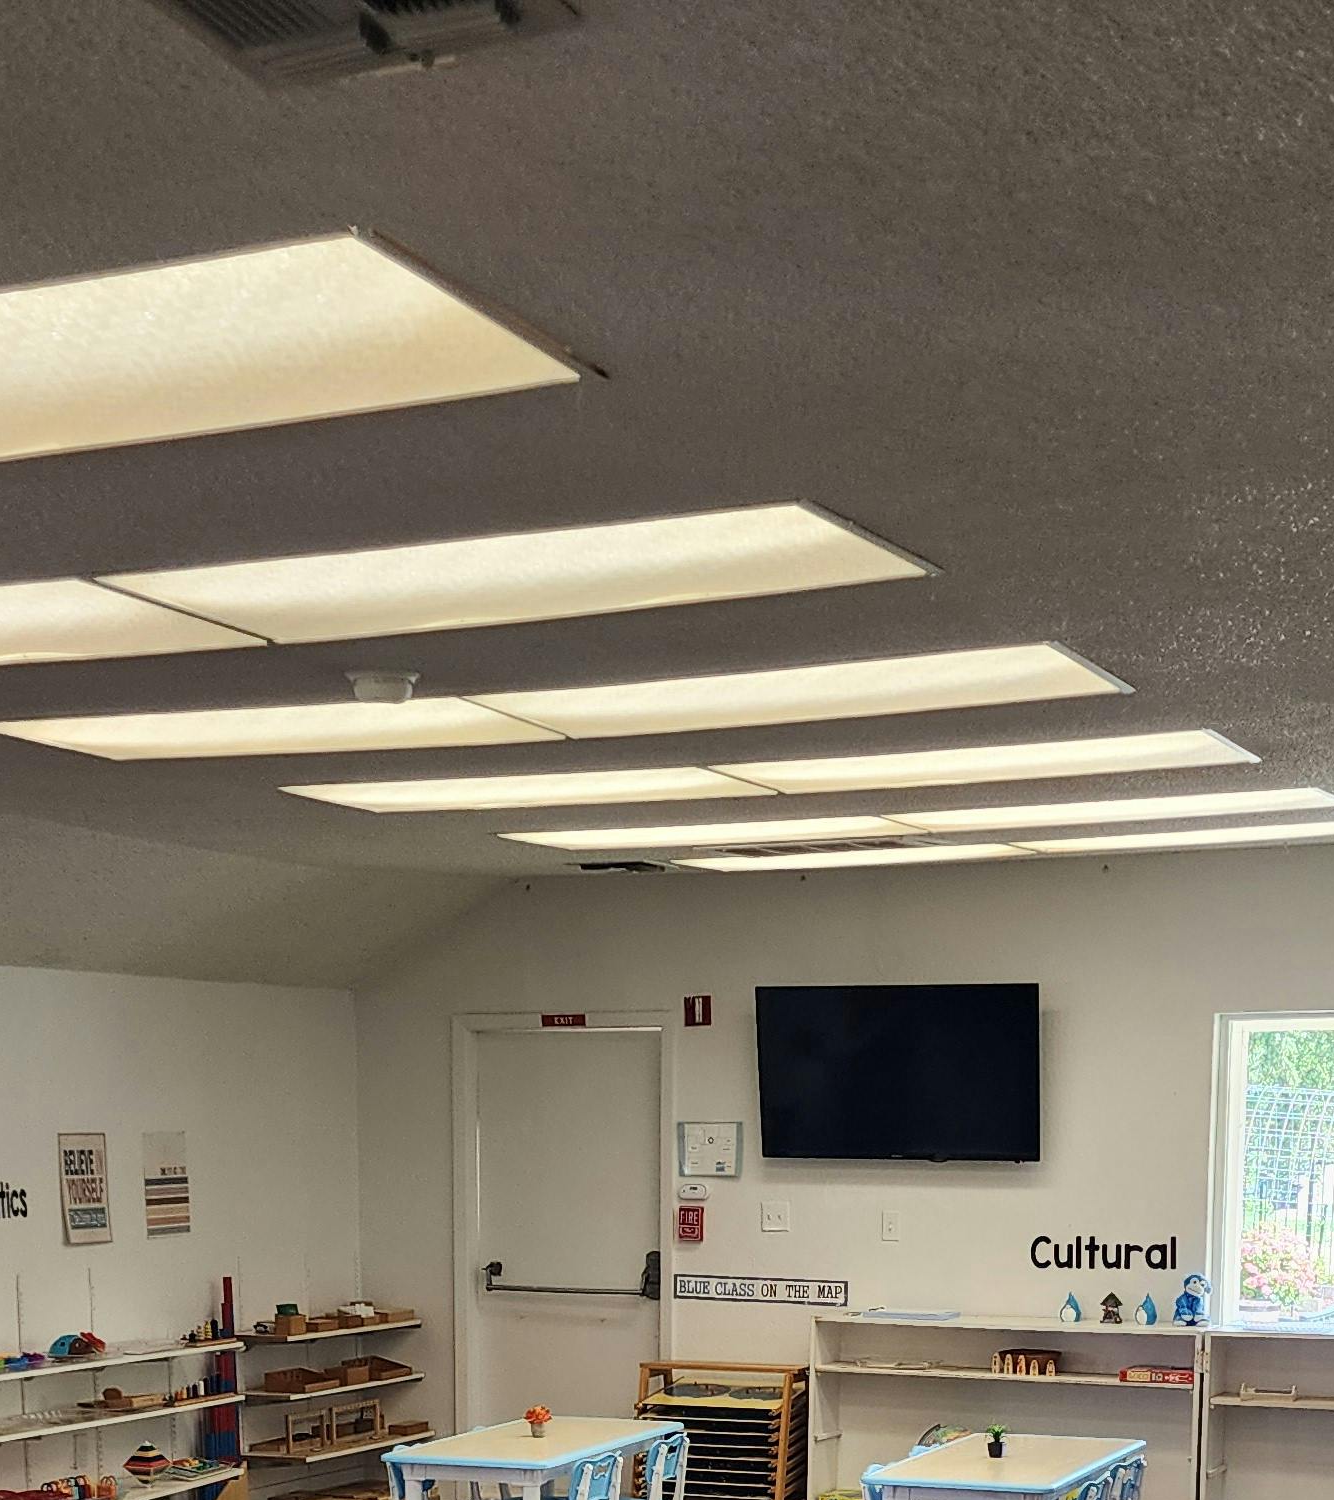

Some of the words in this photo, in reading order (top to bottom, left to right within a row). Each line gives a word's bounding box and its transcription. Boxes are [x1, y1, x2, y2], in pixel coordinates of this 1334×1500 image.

[554, 1016, 574, 1025] EXIT
[63, 1149, 95, 1176] BELIEVE
[66, 1177, 104, 1204] YOURSELF
[679, 1210, 699, 1225] FIRE
[1030, 1236, 1177, 1270] Cultural
[679, 1280, 710, 1295] BLUE
[714, 1282, 754, 1297] CLASS
[761, 1284, 778, 1298] ON
[786, 1285, 809, 1299] THE
[817, 1285, 843, 1299] MAP
